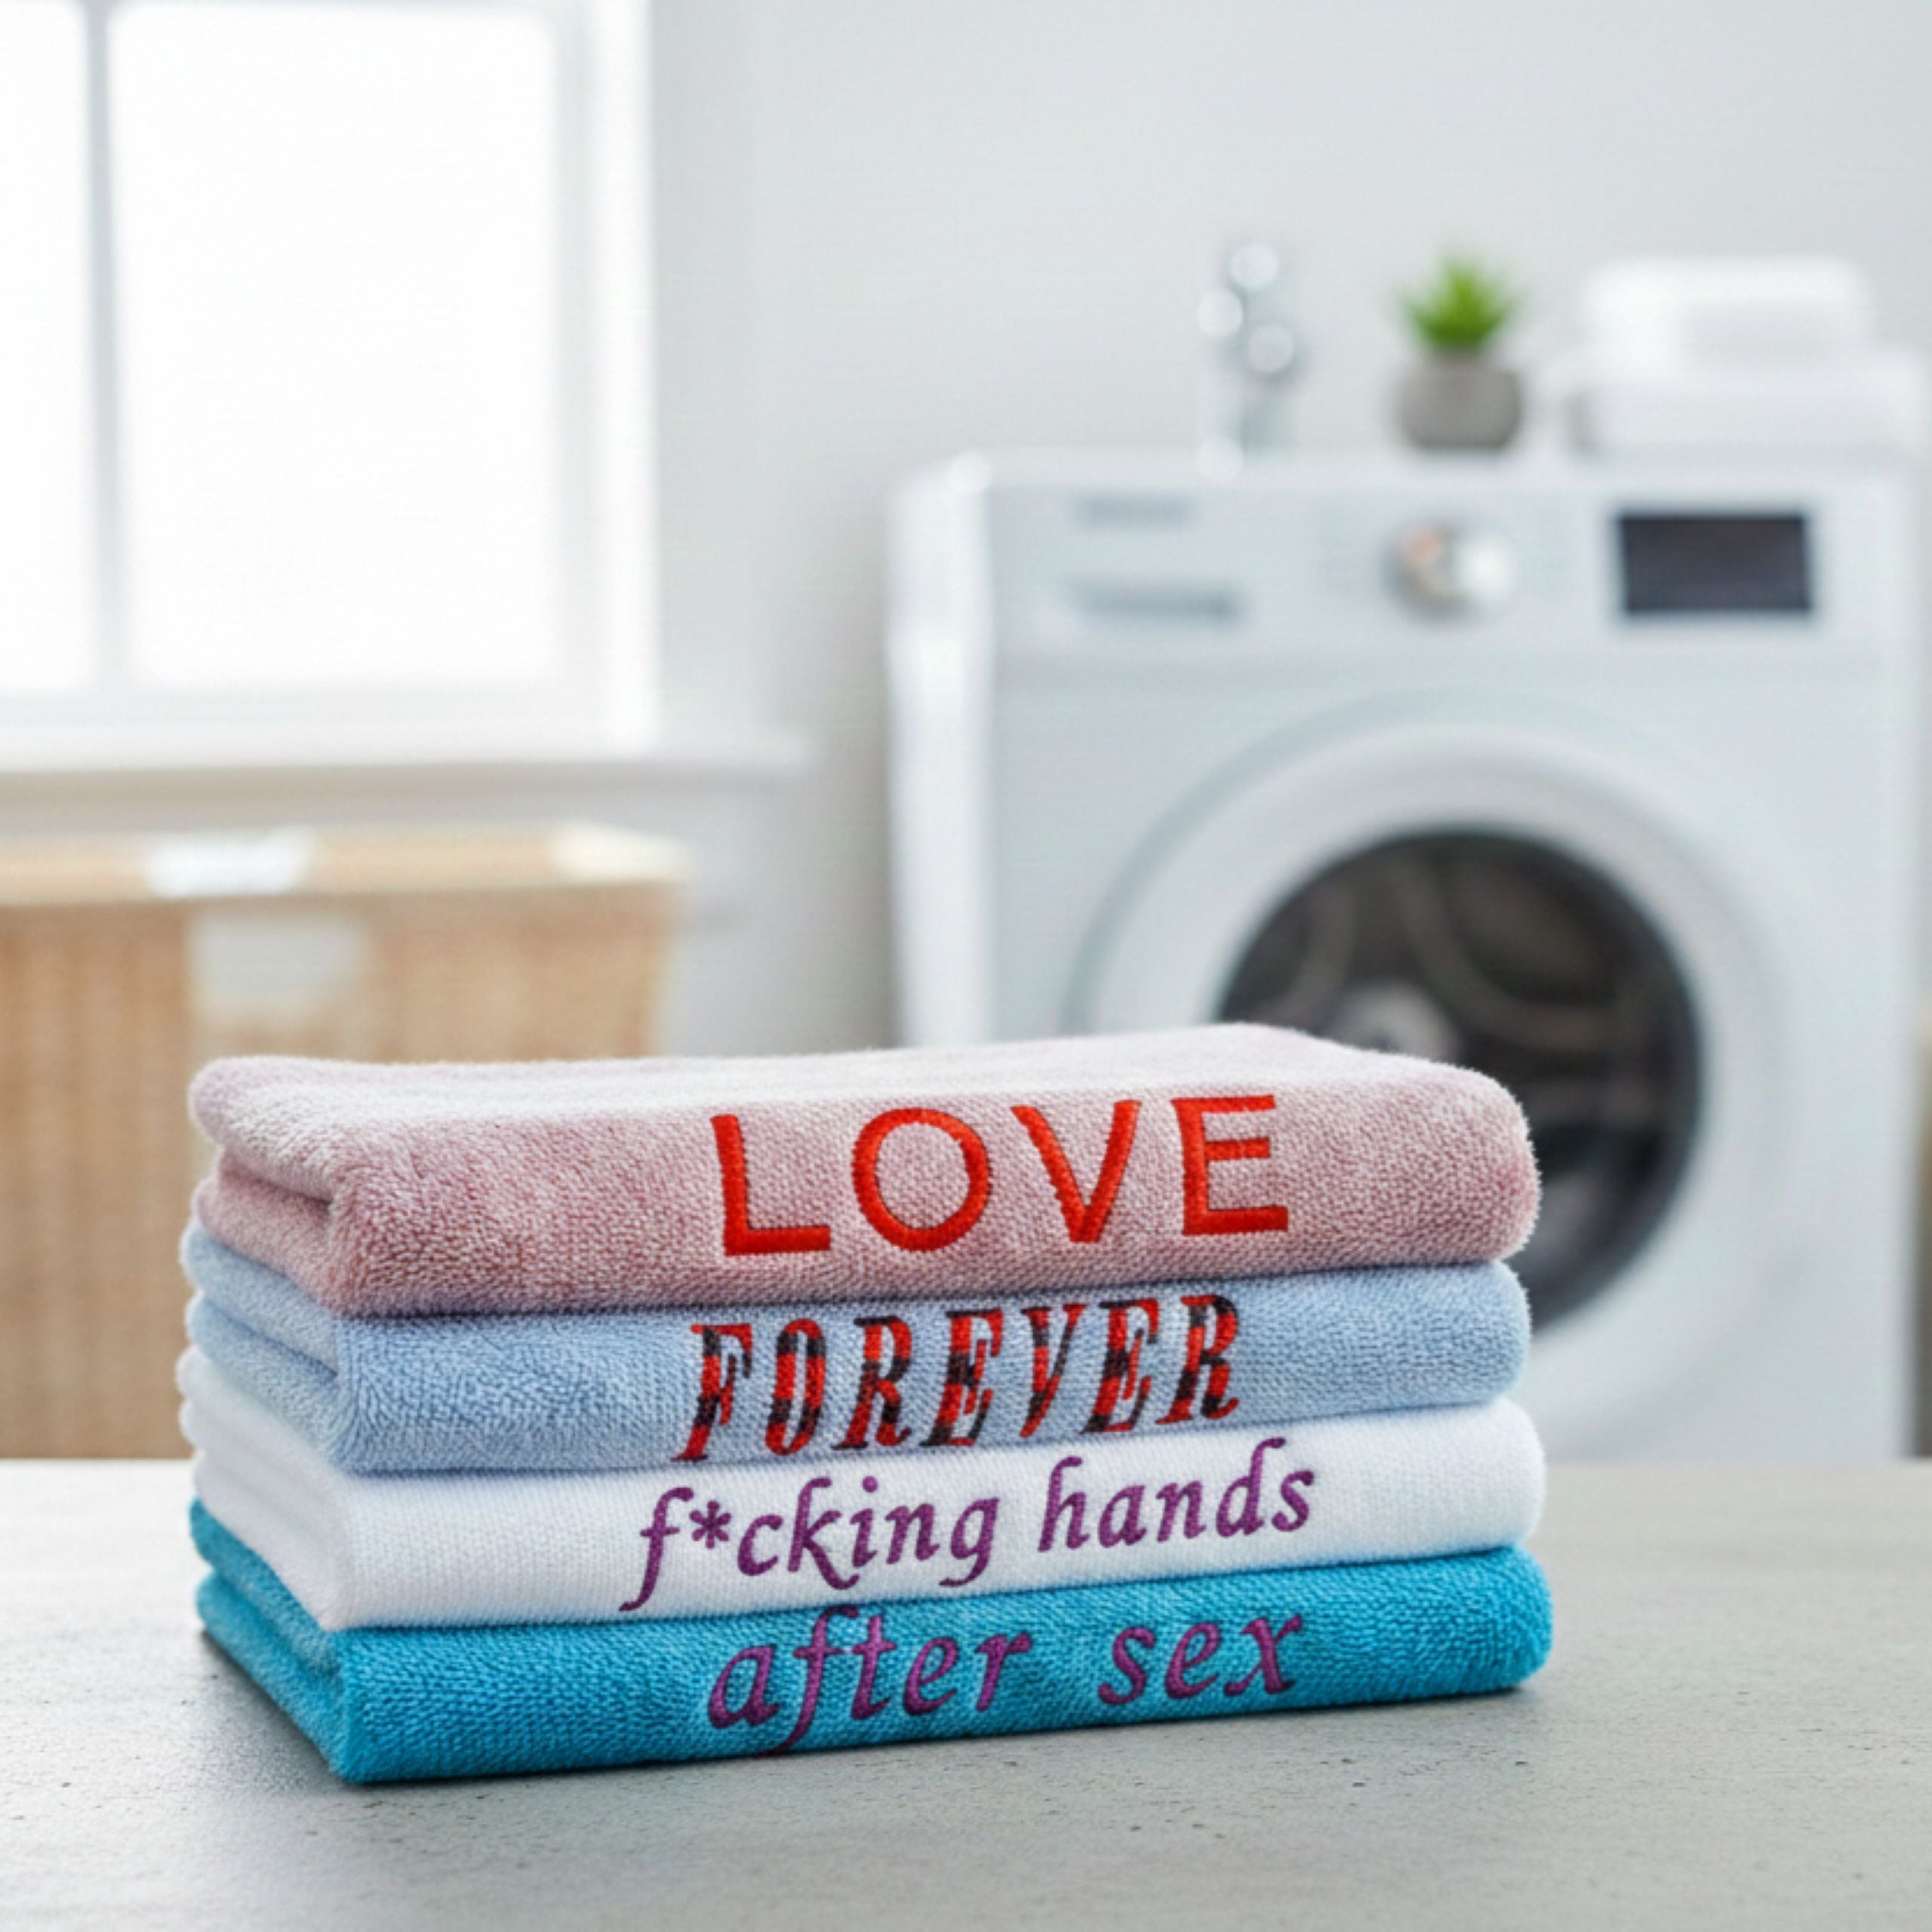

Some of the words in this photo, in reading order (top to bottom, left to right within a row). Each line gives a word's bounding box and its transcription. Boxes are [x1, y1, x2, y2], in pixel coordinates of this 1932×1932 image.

[712, 1094, 1289, 1257] LOVE
[673, 1292, 1239, 1464] FOREVER
[1038, 1437, 1316, 1553] hands
[708, 1606, 1032, 1754] after
[1098, 1614, 1303, 1709] sex
